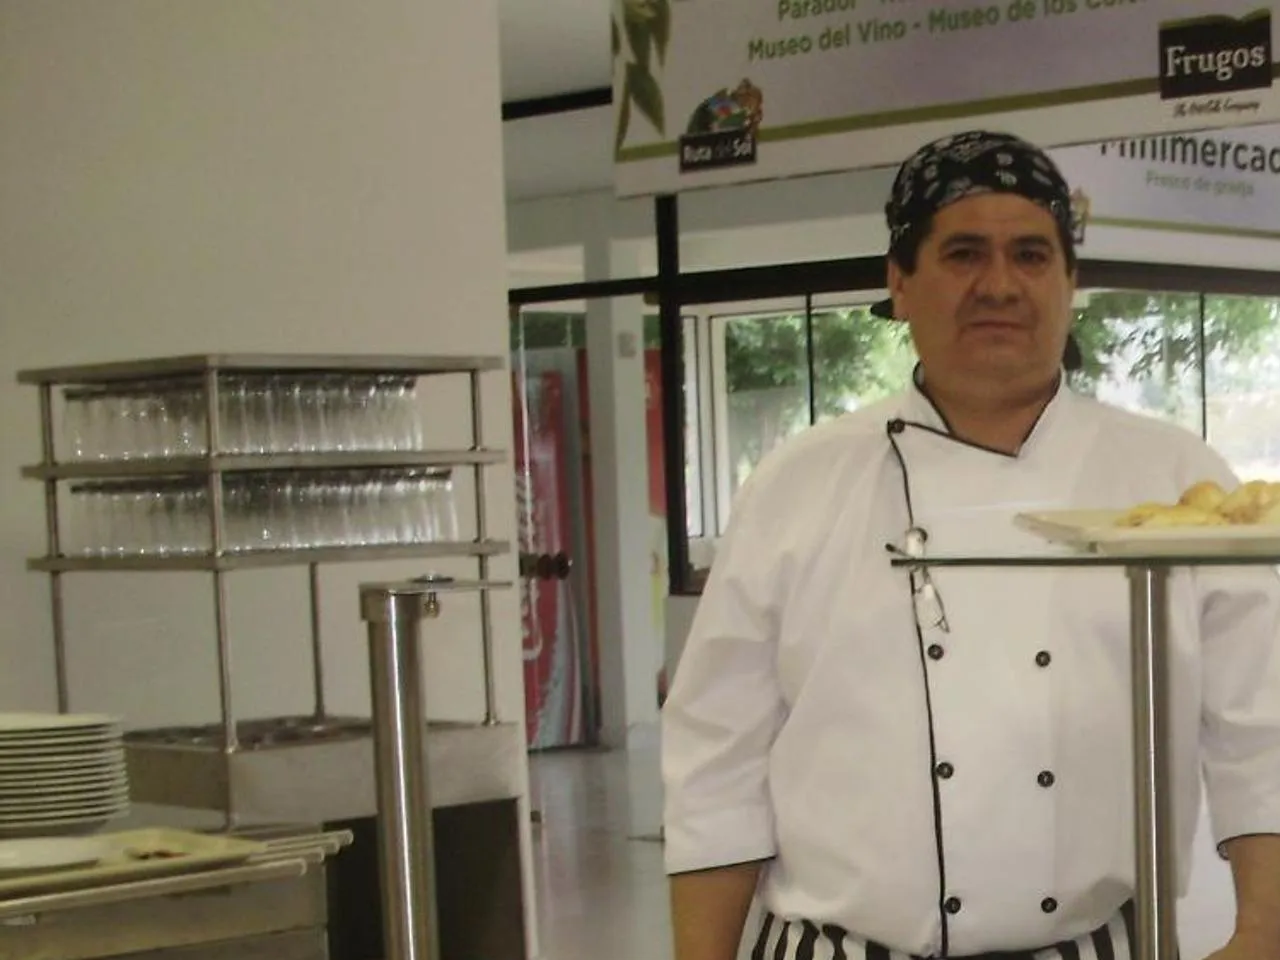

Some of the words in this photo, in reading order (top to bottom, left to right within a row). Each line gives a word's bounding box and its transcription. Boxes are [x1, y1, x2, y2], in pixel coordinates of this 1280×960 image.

[778, 0, 857, 21] Parador
[748, 34, 812, 60] Museo
[818, 23, 850, 51] del
[857, 18, 907, 43] Vino
[928, 6, 1000, 33] Museo
[1007, 0, 1036, 22] de
[1044, 0, 1077, 16] los
[1166, 45, 1266, 81] Frugos
